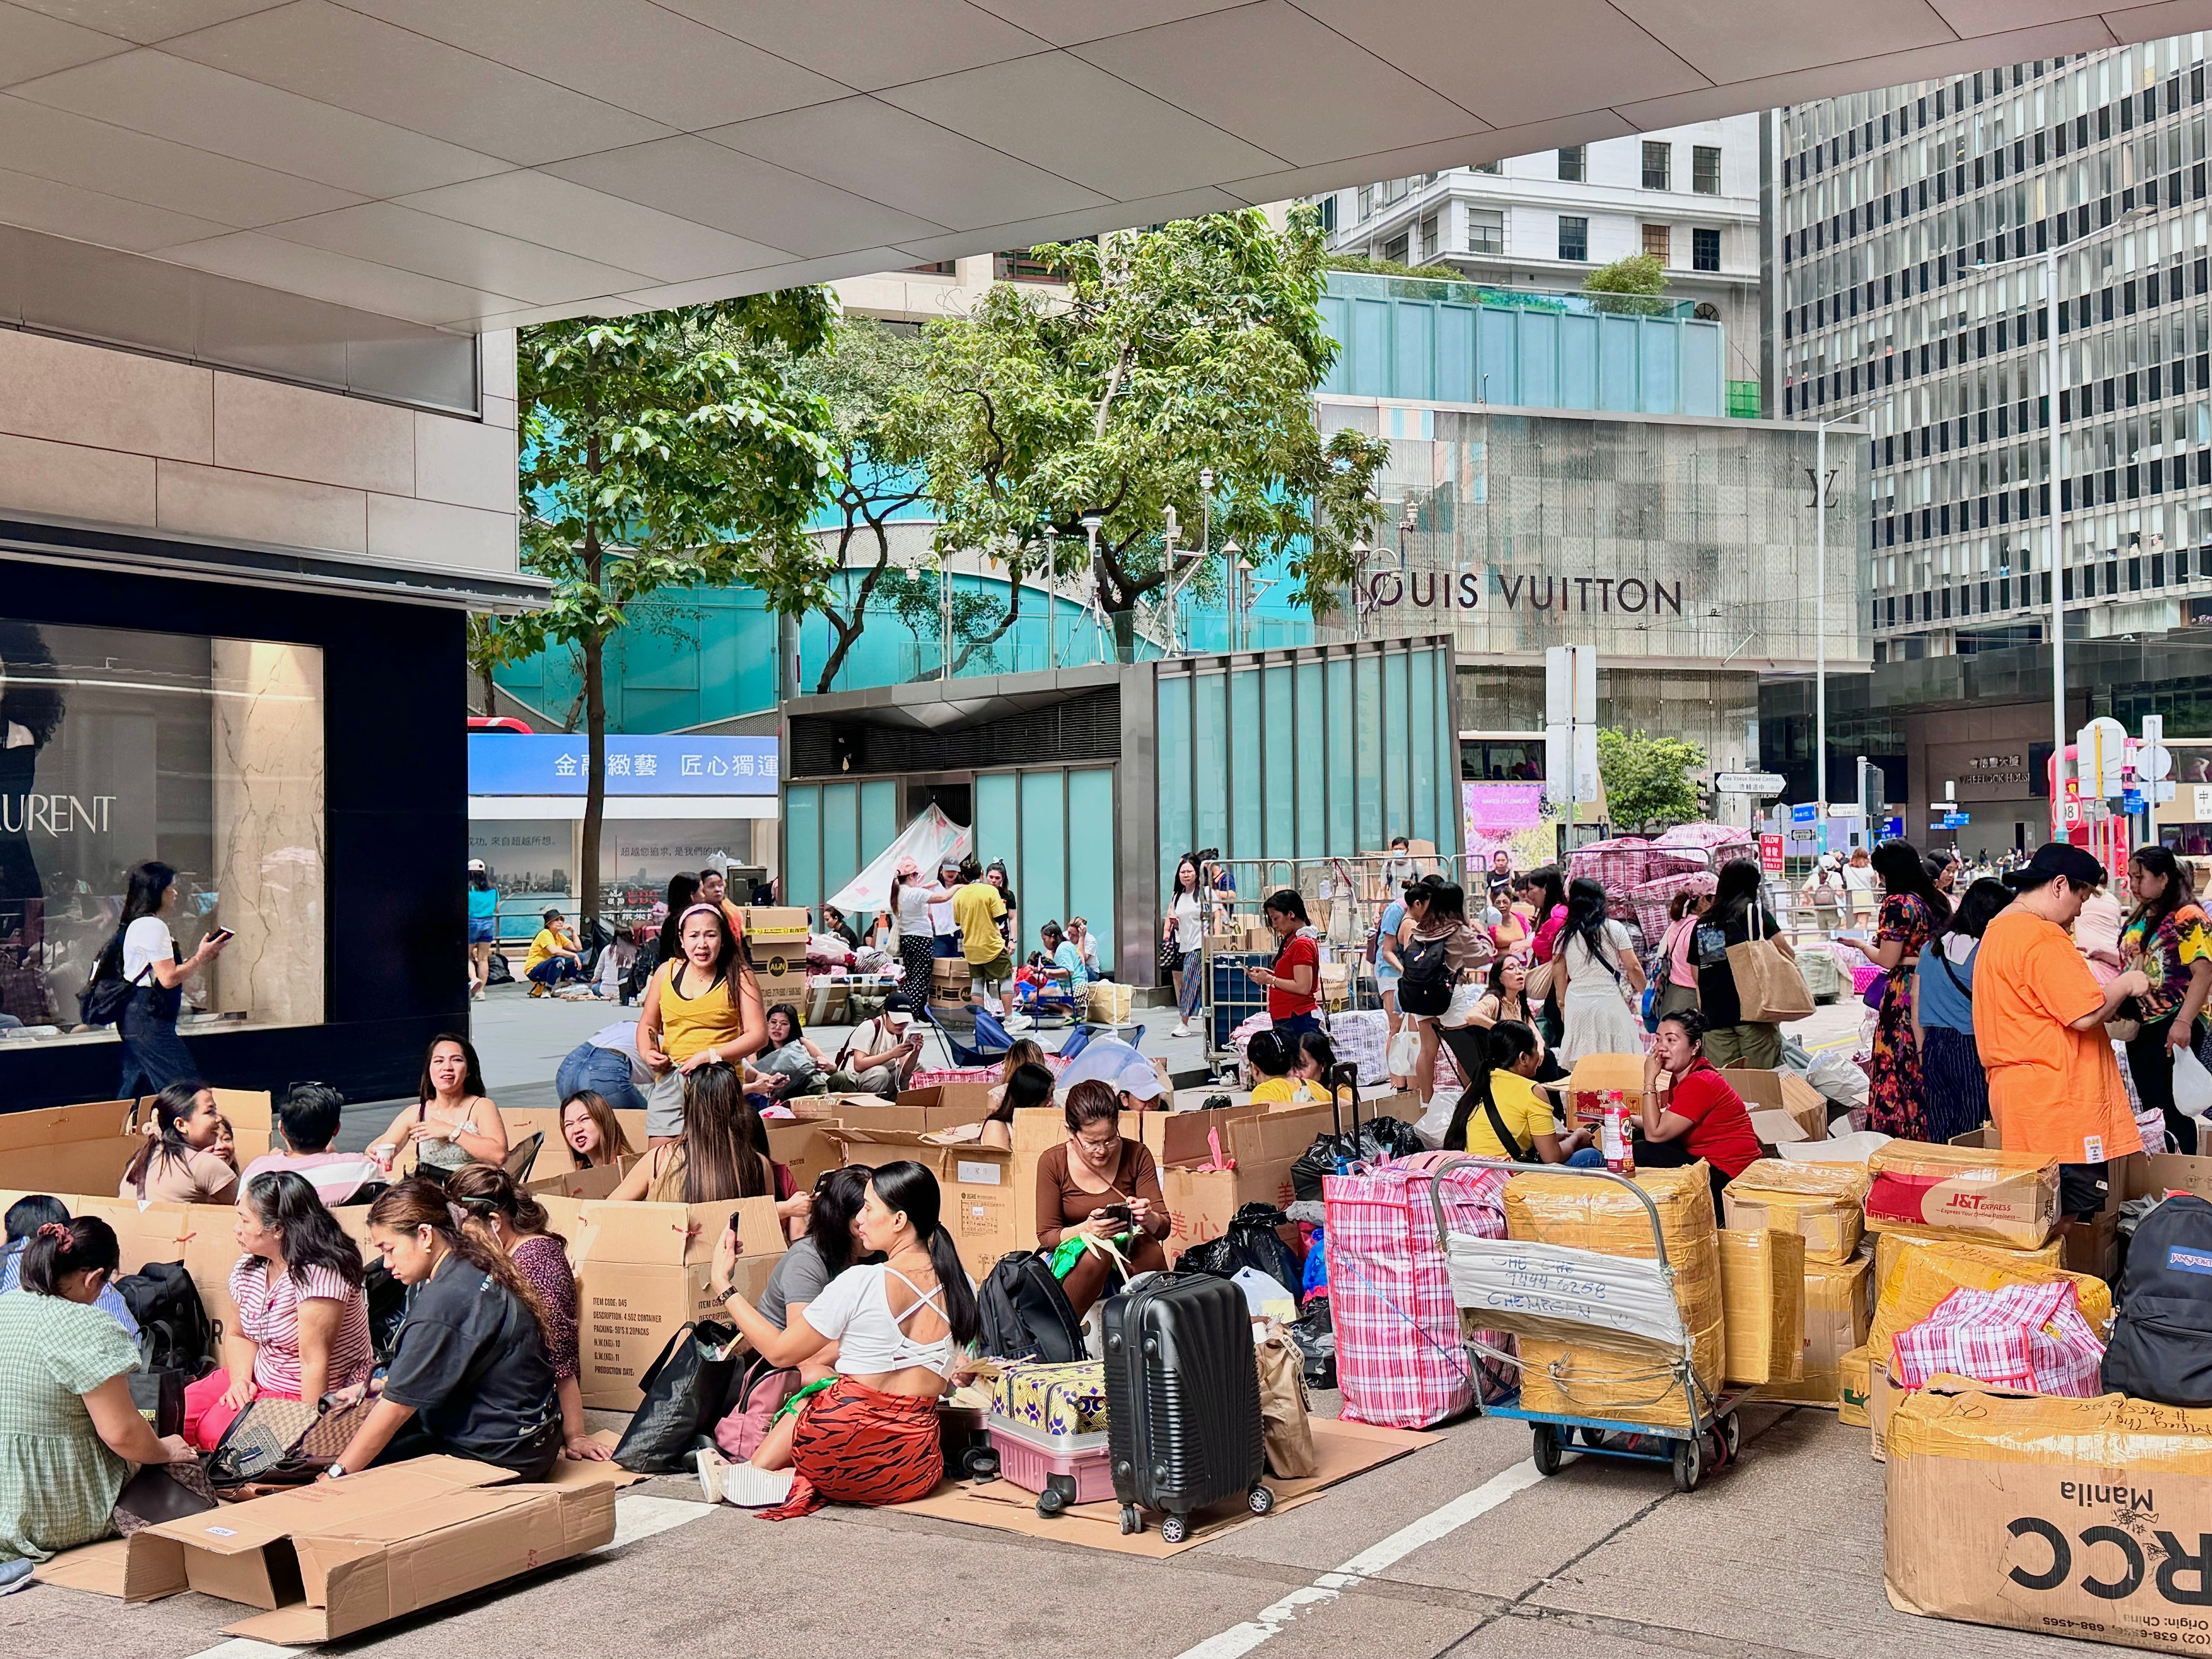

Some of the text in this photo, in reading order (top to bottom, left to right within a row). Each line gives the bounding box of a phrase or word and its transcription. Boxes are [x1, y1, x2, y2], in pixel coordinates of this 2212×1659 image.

[1497, 574, 1681, 615] VUITTON
[681, 754, 779, 776] 匠心獨運
[2006, 772, 2030, 783] HOUS
[0, 795, 116, 837] URENT
[1764, 836, 1779, 844] SLOW
[1946, 1193, 2011, 1212] J&T EXPRESS
[1171, 1210, 1220, 1243] 美心
[593, 1297, 604, 1306] ITEM
[698, 1300, 711, 1310] ITEM
[637, 1313, 662, 1323] CONTAINER
[615, 1339, 620, 1348] 10
[615, 1353, 619, 1361] 11
[595, 1365, 622, 1375] PRODUCTION
[2061, 1481, 2153, 1512] Manila
[2042, 1617, 2105, 1632] 688-4565
[2124, 1613, 2209, 1631] Origin: China
[2182, 1633, 2211, 1645] (02)
